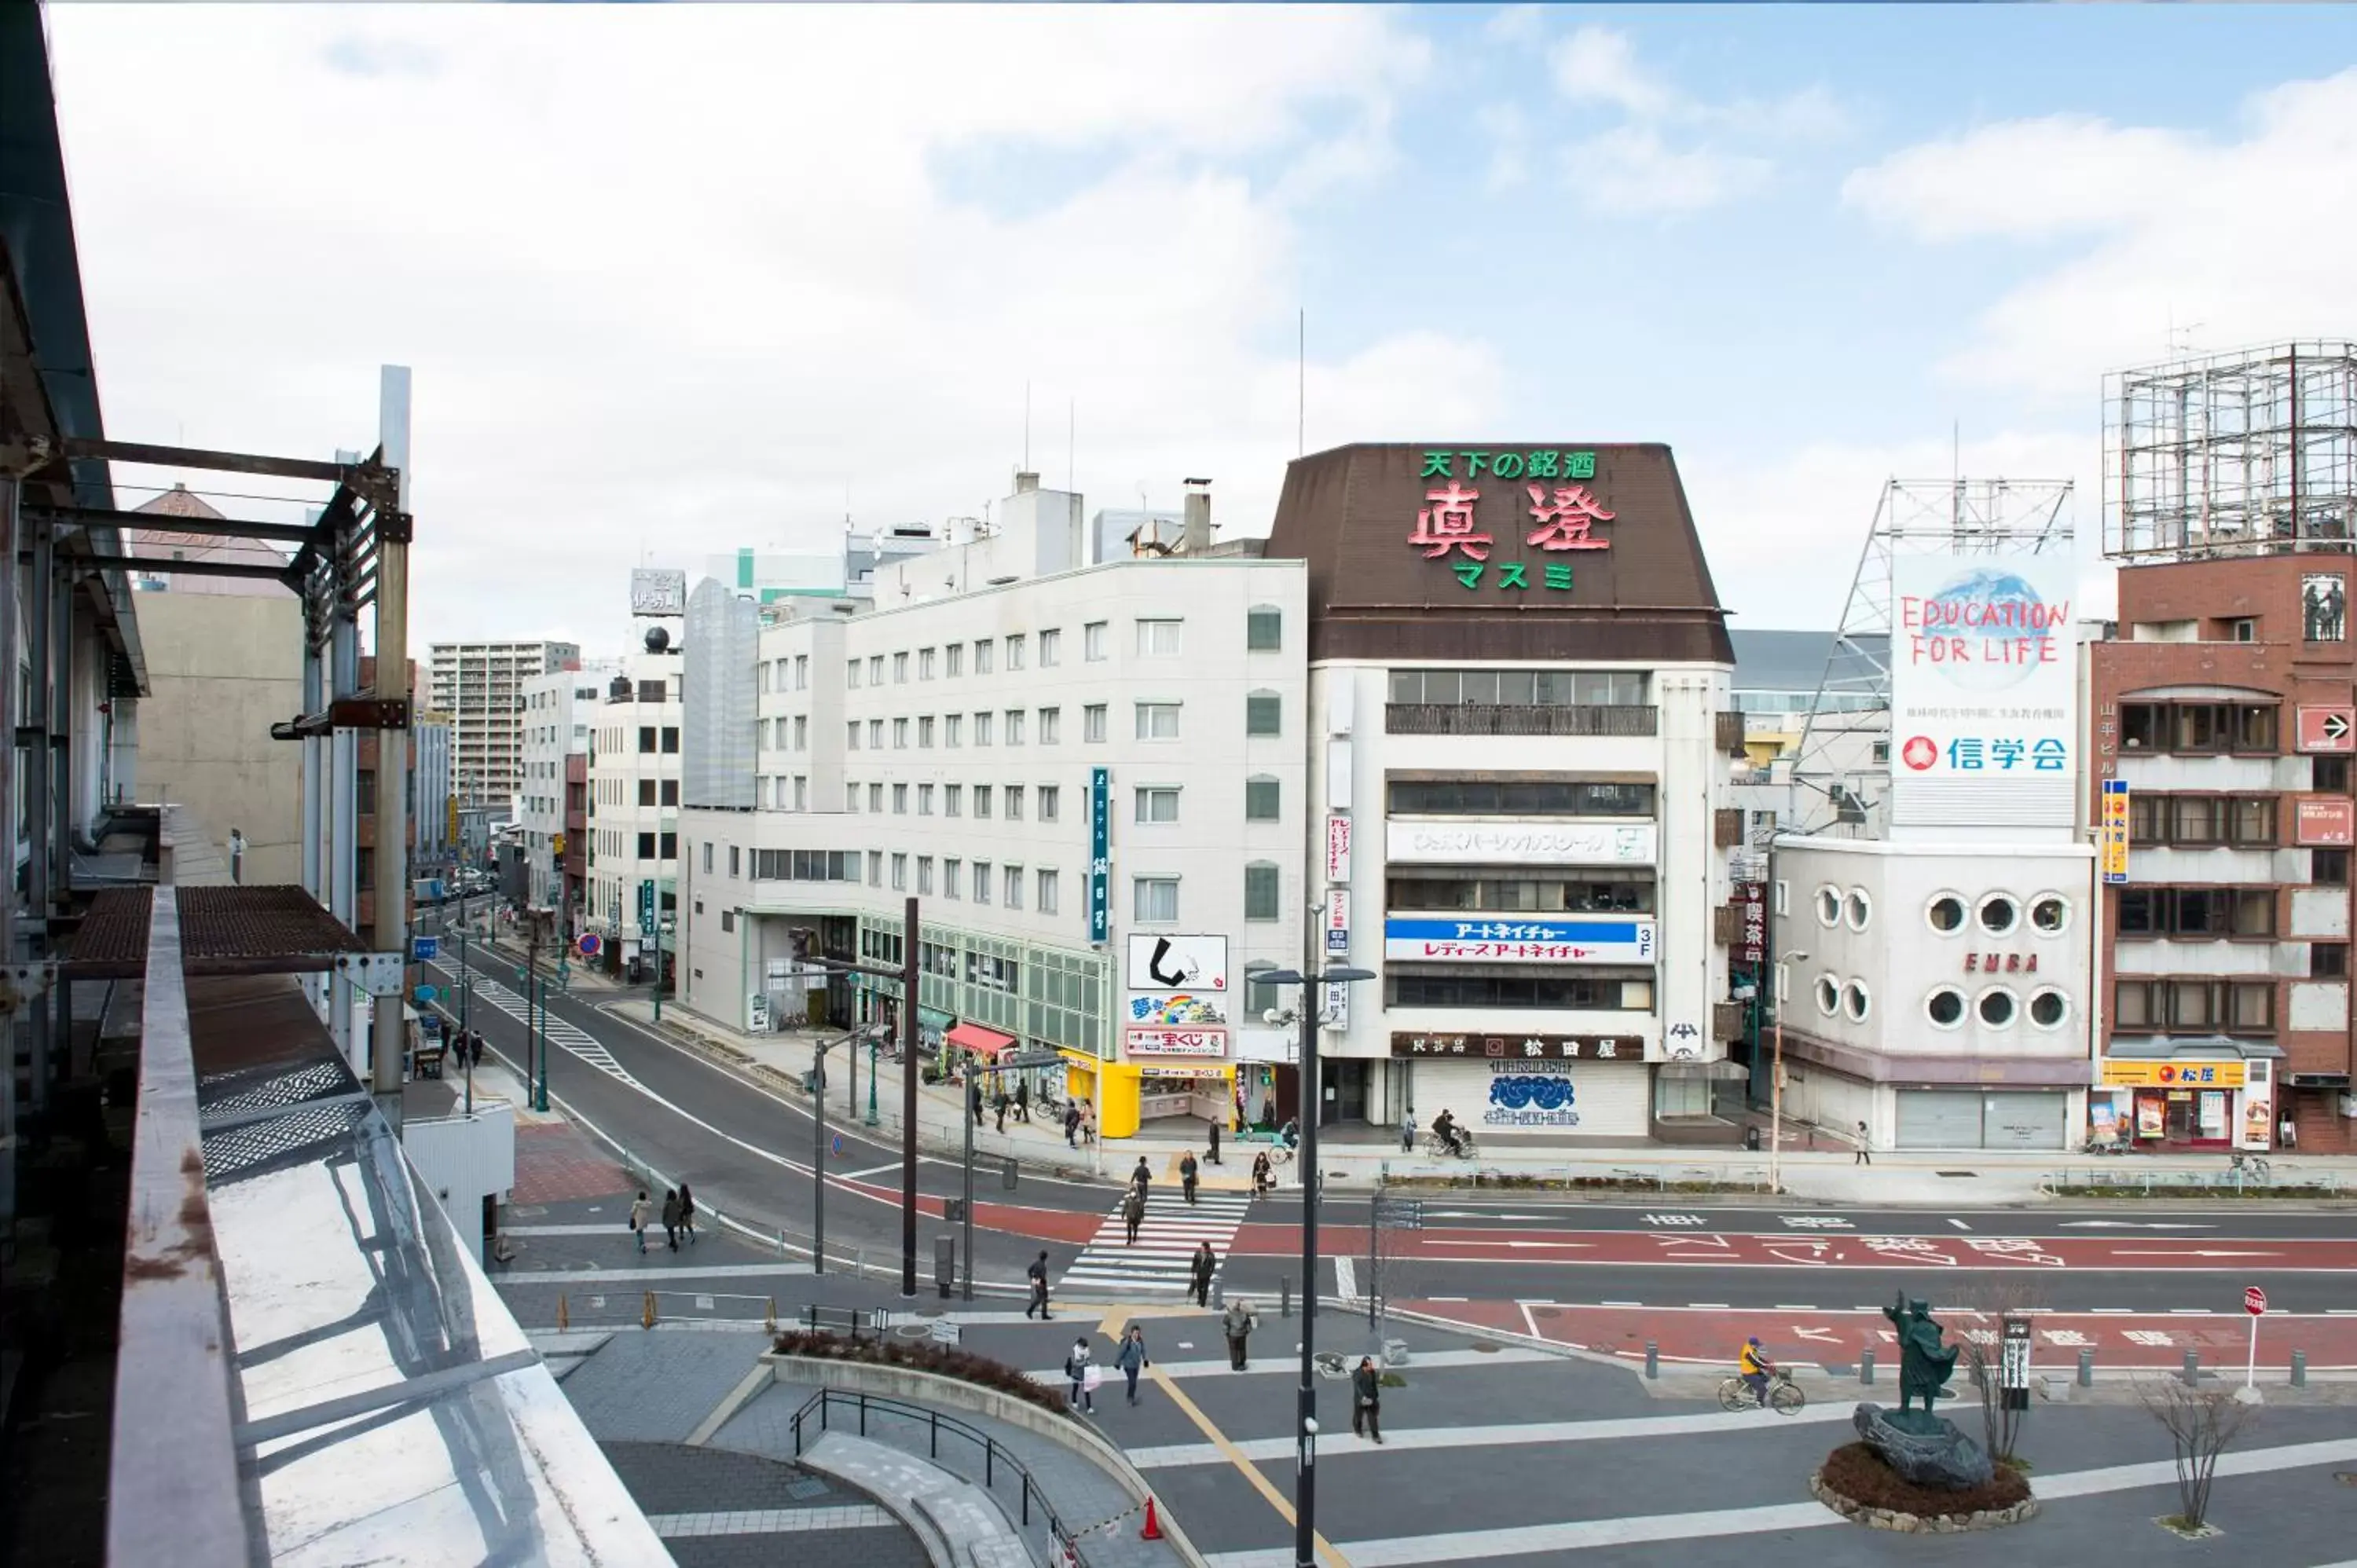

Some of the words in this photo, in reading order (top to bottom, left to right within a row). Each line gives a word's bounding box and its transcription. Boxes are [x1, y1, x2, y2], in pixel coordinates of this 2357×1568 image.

[1420, 451, 1596, 479] 天下の銘酒
[1450, 562, 1574, 590] マスミ
[1901, 596, 2069, 629] EDUCATION
[1911, 635, 1970, 665] FOR
[1984, 636, 2058, 665] LIFE
[1946, 738, 2068, 771] 信学会
[1456, 923, 1567, 939] アートネイチャー
[1424, 942, 1490, 957] レディース
[1494, 943, 1596, 958] アートネイチャー
[1162, 1032, 1203, 1046] 宝くじ
[1523, 1039, 1617, 1058] 松田屋
[2180, 1067, 2215, 1082] 松屋
